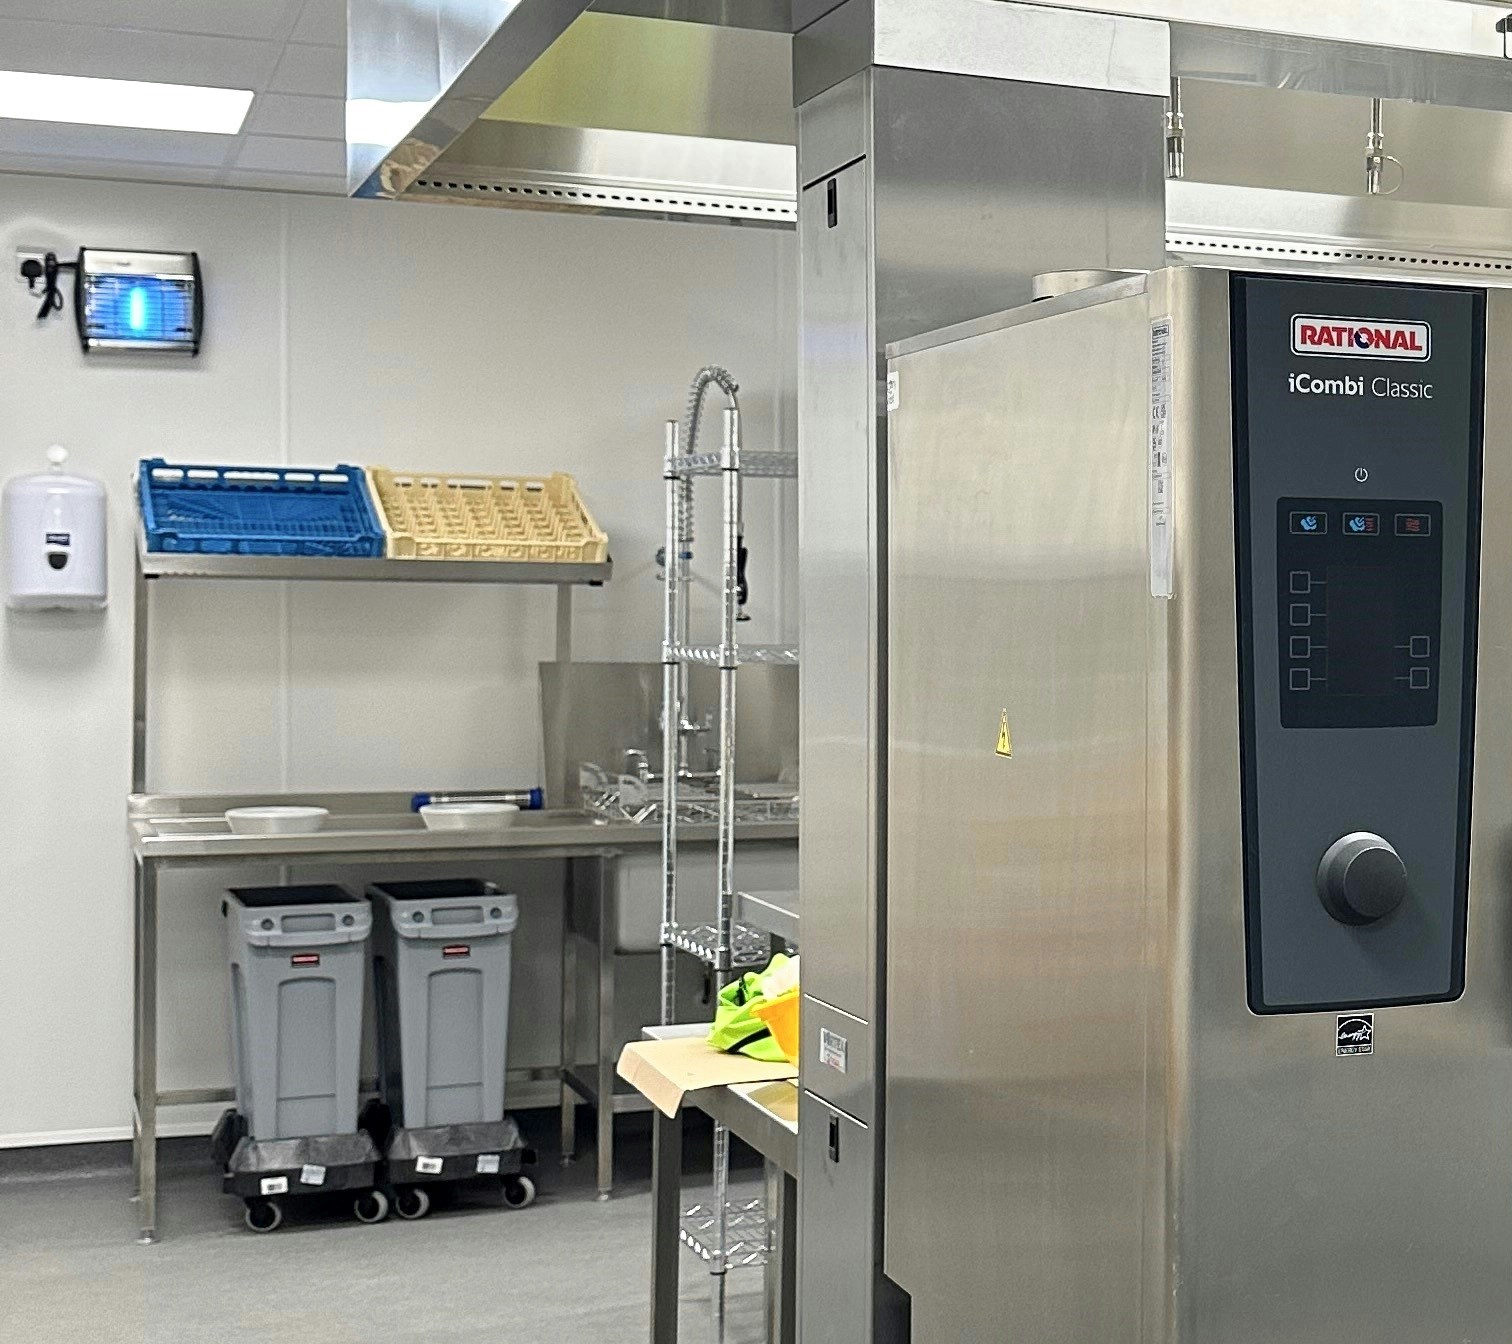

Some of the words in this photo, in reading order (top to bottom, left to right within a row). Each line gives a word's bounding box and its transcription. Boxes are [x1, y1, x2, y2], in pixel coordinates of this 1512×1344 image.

[1300, 324, 1423, 352] RATIONAL
[1288, 373, 1364, 396] iCombi
[1371, 377, 1433, 399] Classic
